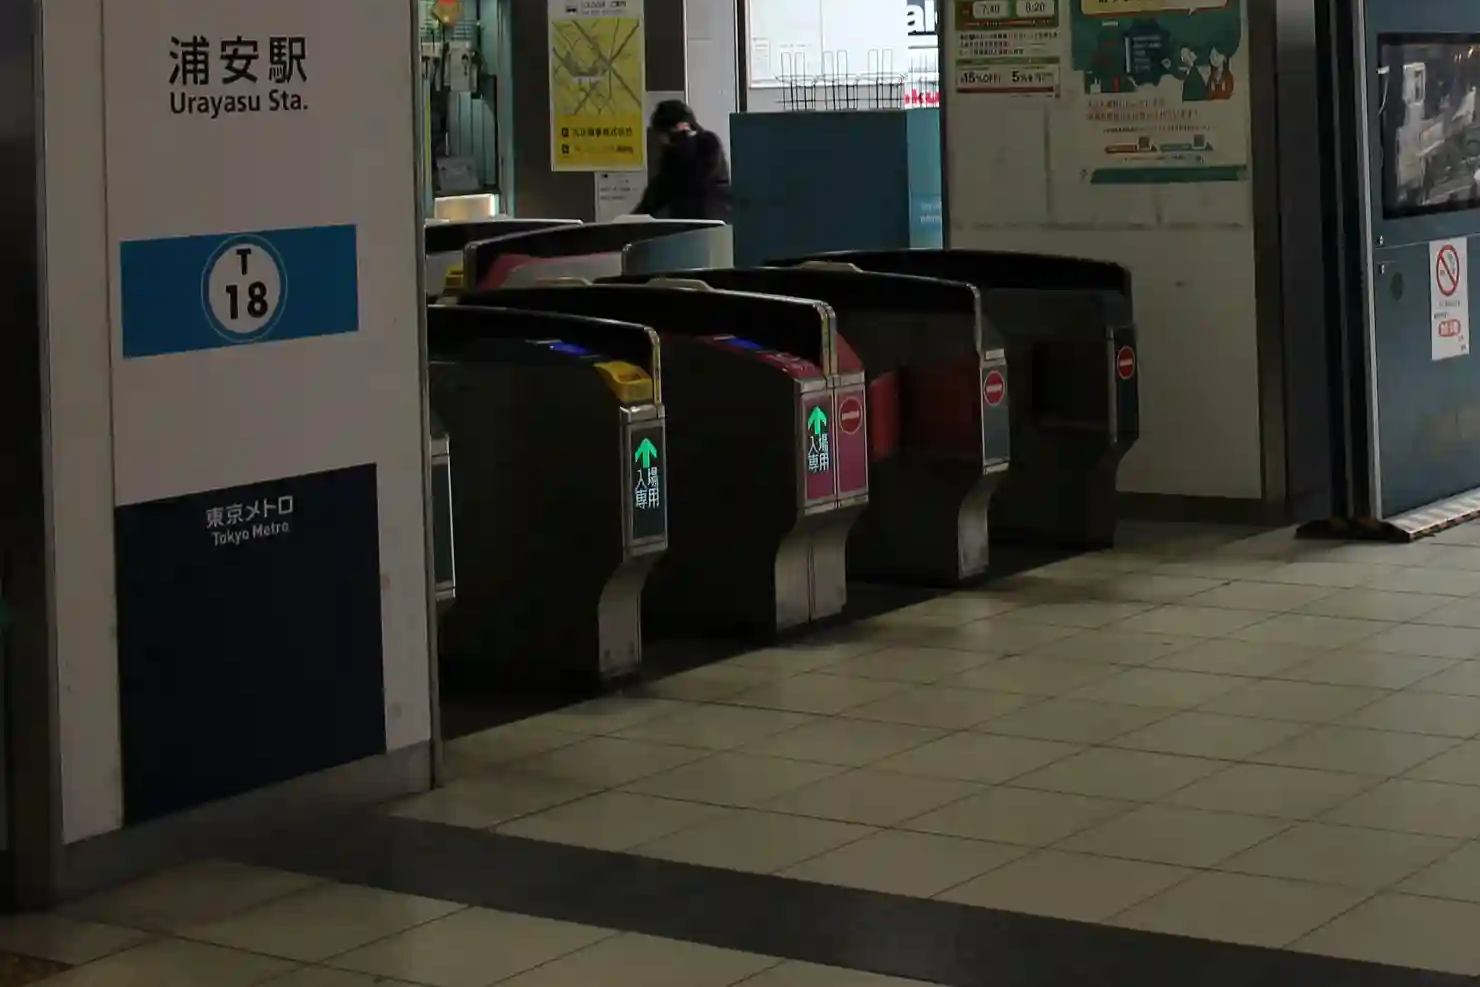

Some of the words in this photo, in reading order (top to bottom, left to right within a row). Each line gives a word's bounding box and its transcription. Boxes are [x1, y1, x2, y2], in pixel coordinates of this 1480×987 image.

[169, 35, 308, 85] 浦安駅
[169, 91, 261, 119] Urayasu
[268, 89, 308, 112] Sta.
[236, 248, 252, 276] T
[226, 280, 269, 321] 18
[807, 433, 829, 455] 入場
[808, 452, 830, 473] 専用
[634, 466, 659, 490] 入場
[635, 488, 660, 509] 専用
[206, 496, 294, 529] 東京メトロ
[212, 529, 250, 547] Tokyo
[252, 522, 289, 540] Metro
